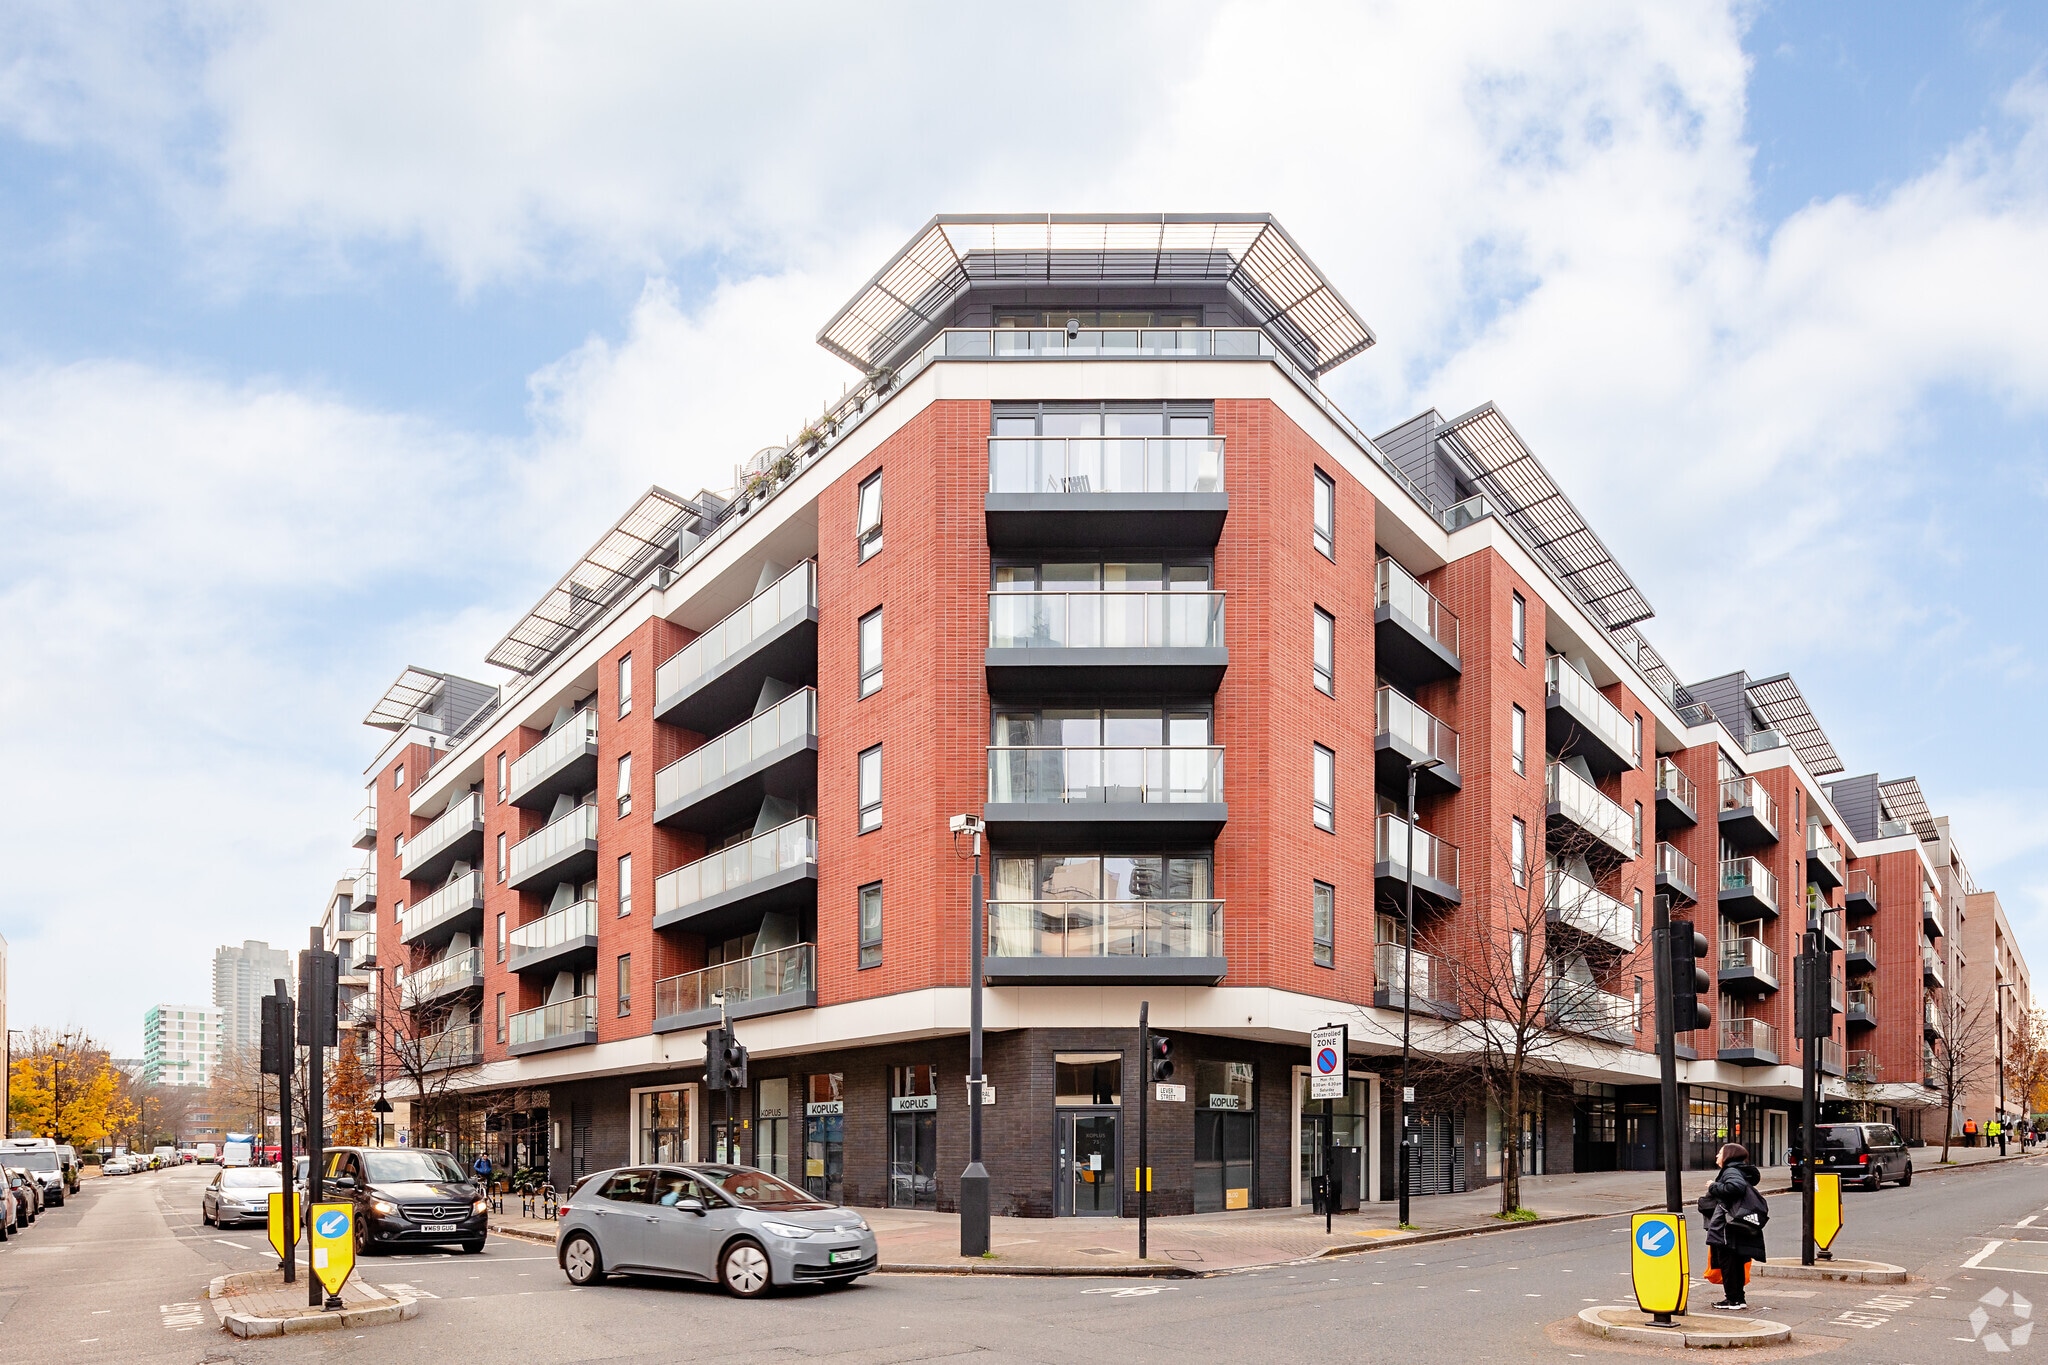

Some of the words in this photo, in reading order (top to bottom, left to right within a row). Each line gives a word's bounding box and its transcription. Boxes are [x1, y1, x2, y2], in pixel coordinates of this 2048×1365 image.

[1313, 1030, 1341, 1039] Controlled
[1317, 1038, 1337, 1047] ZONE
[900, 1099, 928, 1109] KOPLUS
[1211, 1097, 1239, 1108] KOPLUS
[761, 1108, 782, 1117] KOPLUS
[811, 1104, 838, 1114] KOPLUS
